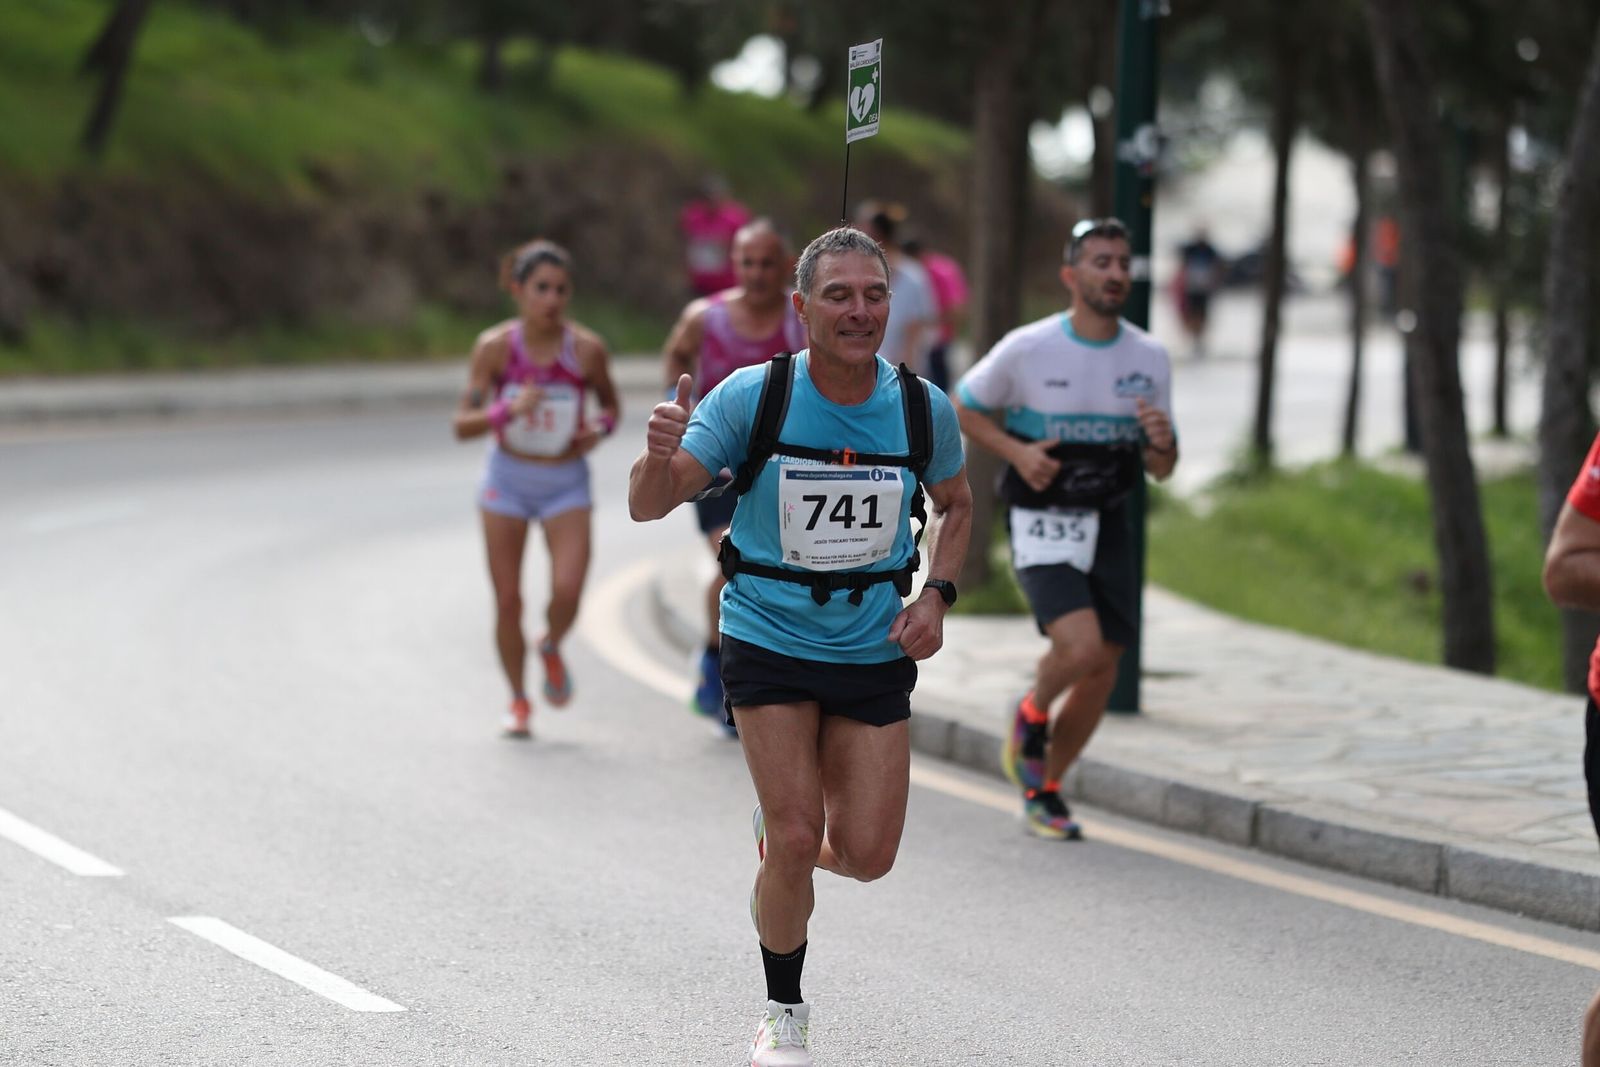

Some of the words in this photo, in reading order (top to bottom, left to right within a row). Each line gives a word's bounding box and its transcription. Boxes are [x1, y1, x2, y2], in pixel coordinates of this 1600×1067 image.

[868, 113, 878, 123] DEA
[802, 494, 883, 531] 741
[1028, 518, 1087, 543] 435
